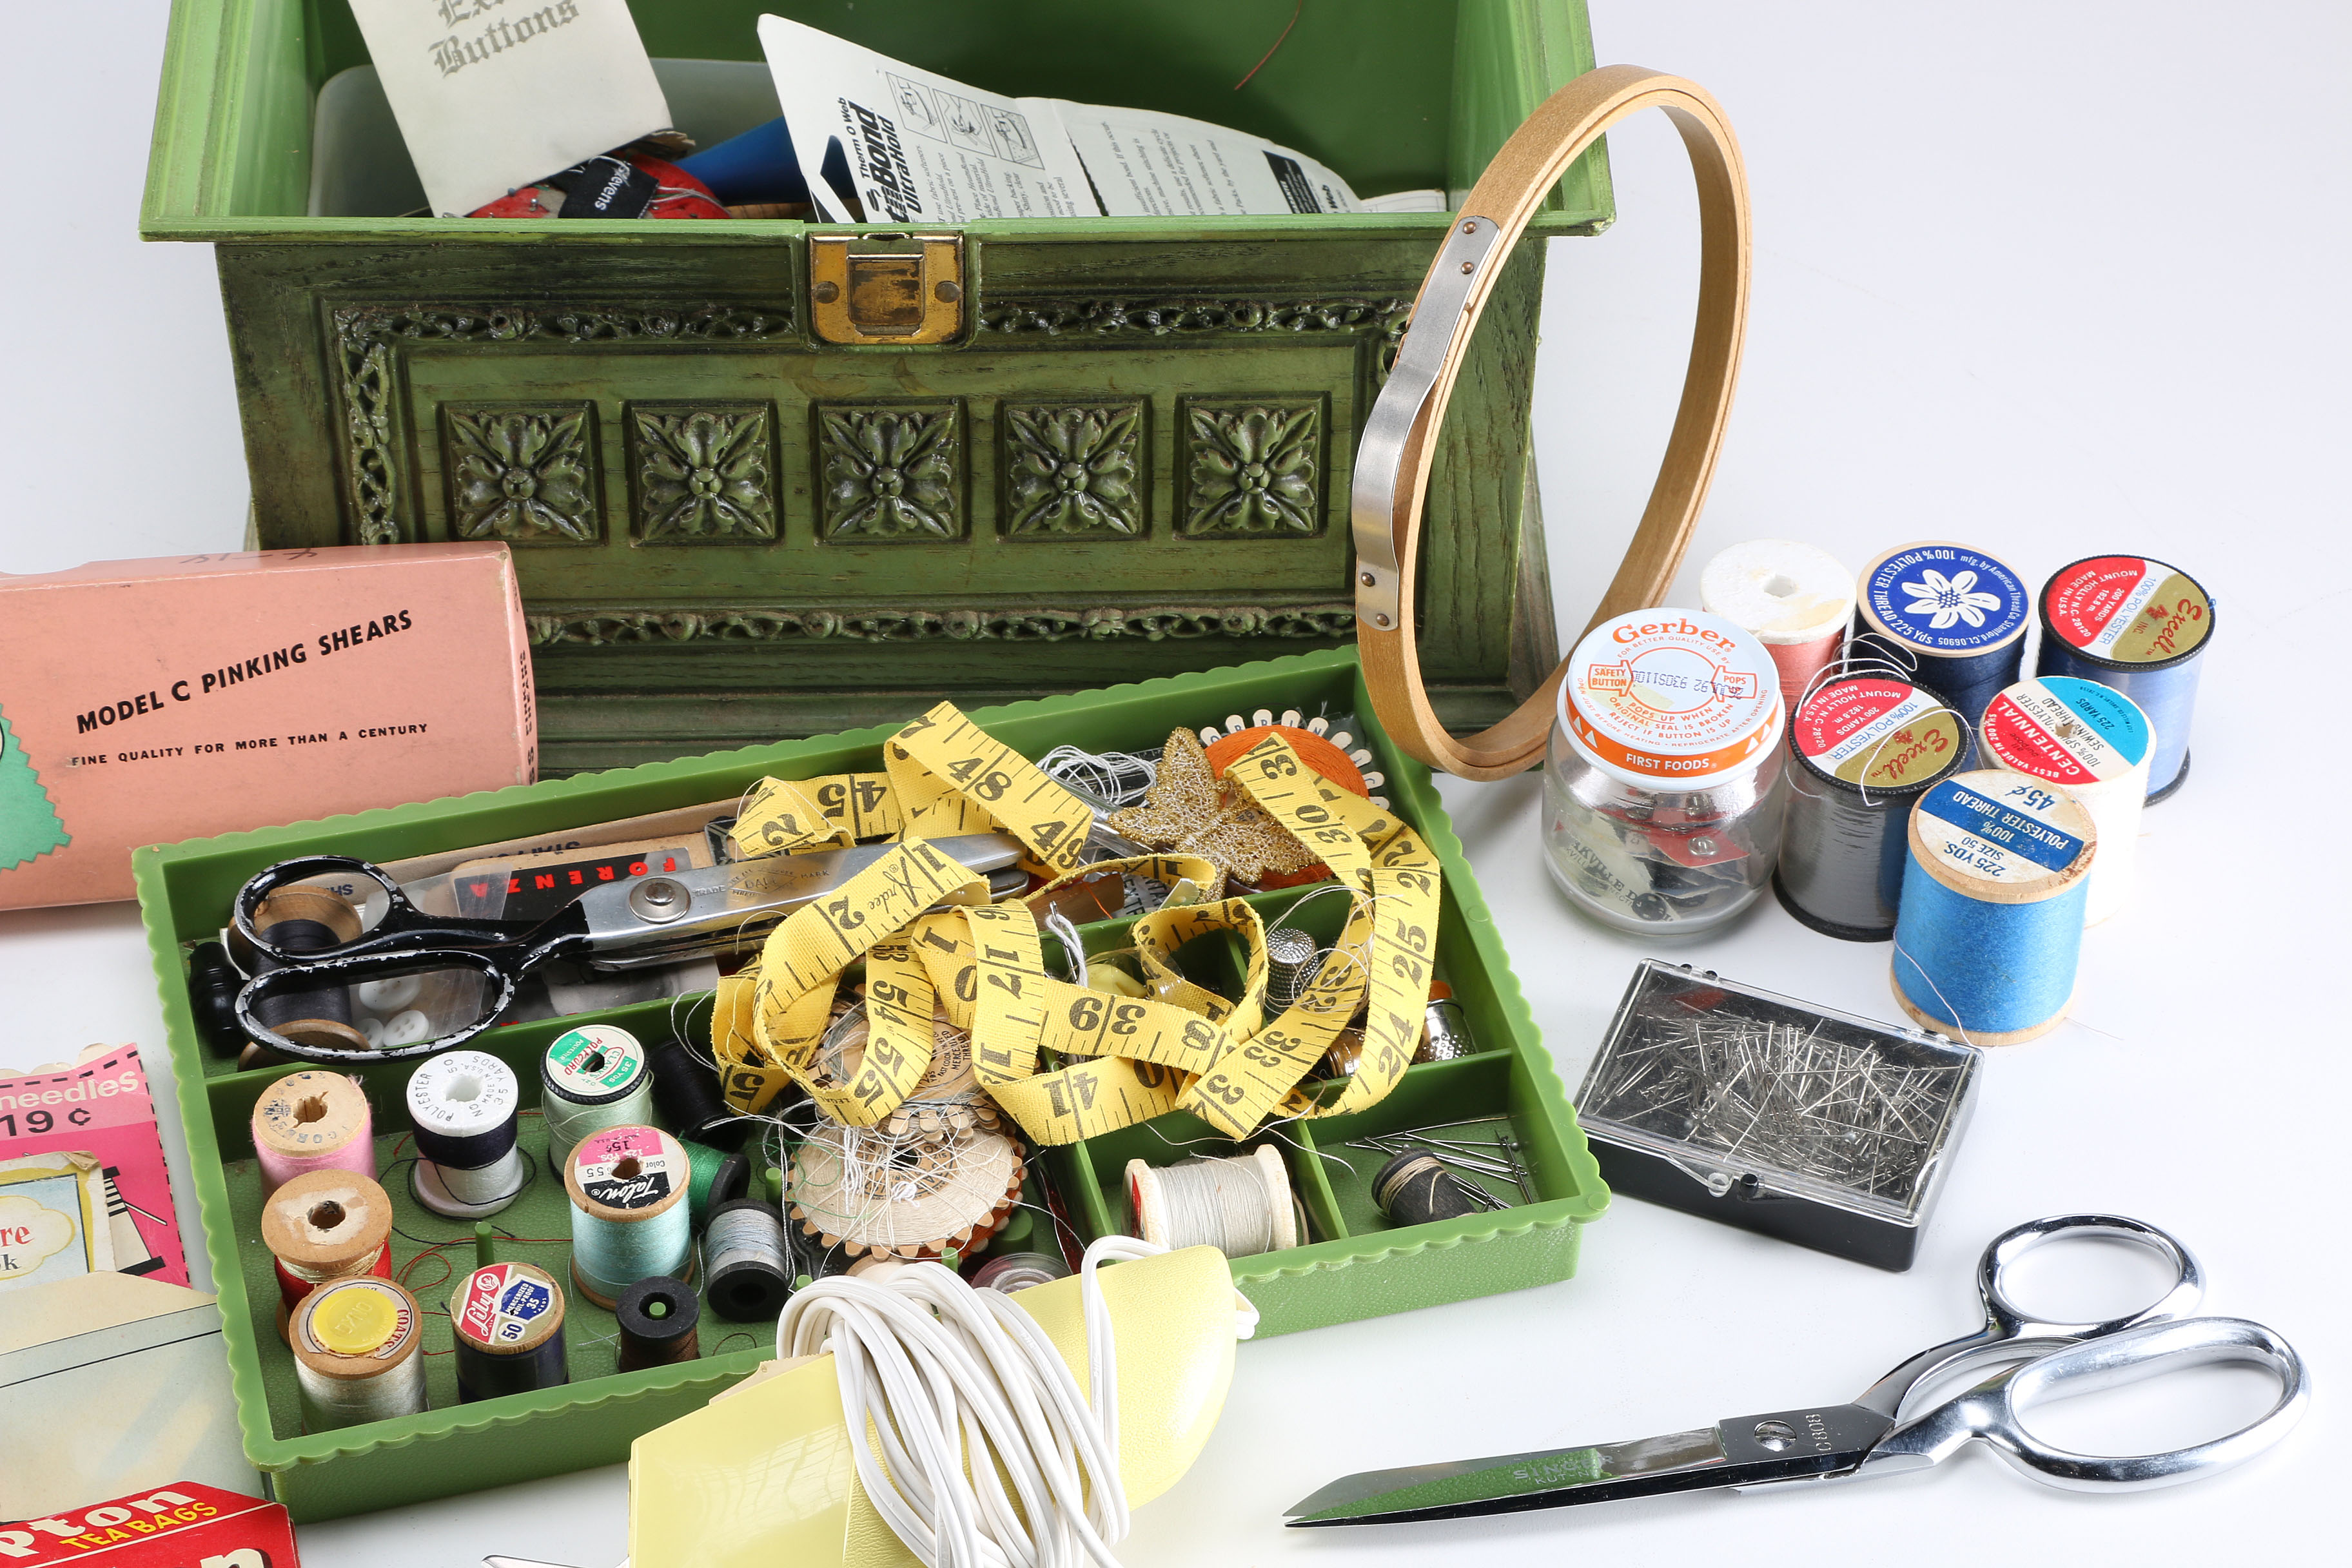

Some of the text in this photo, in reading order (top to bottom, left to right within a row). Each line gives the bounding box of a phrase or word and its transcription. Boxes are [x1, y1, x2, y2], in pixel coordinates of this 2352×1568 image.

[428, 0, 580, 78] Buttons
[837, 97, 870, 179] Therm O Web
[877, 114, 923, 214] UltraHold
[939, 153, 951, 172] piece
[972, 193, 982, 211] Place
[1874, 549, 1955, 645] 100% POLYESTER THREAD 225 Yds
[2063, 571, 2096, 596] MADE IN
[2095, 589, 2110, 607] 182.8
[1938, 555, 2021, 646] mfg. by American Thread 06905
[2072, 570, 2137, 637] MOUNT HOLLY 28120
[2095, 588, 2124, 622] 200 YARDS
[2099, 577, 2157, 645] 100% POLYESTER
[1612, 618, 1736, 650] Gerber
[2133, 622, 2149, 634] INC.
[2154, 599, 2202, 654] Excell
[1618, 636, 1731, 664] FOR BETTER QUALITY USE BY
[77, 609, 412, 734] MODEL C PINKING SHEARS
[1592, 678, 1626, 687] BUTTON
[1594, 668, 1626, 677] SAFETY
[1723, 675, 1747, 685] POPS
[1609, 697, 1650, 727] ORIGINAL
[1698, 704, 1734, 727] BROKEN
[1629, 702, 1655, 718] POPS
[1680, 707, 1713, 721] WHEN
[1817, 685, 1858, 707] MADE IN
[1828, 694, 1857, 711] HOLLY
[1842, 705, 1863, 719] 182.8
[1577, 678, 1768, 747] OPEN JUST BEFORE HEATING REFRIGERATE AFTER OPENING
[1609, 712, 1640, 731] REJECT
[1718, 719, 1731, 728] UP
[1836, 707, 1879, 736] 200 YARDS
[2043, 698, 2073, 727] THREAD
[2075, 698, 2115, 730] 225 YARDS
[72, 723, 427, 766] FINE QUALITY FOR MORE THAN A CENTURY
[1812, 728, 1826, 748] 28120
[1830, 702, 1918, 760] 100% POLYESTER
[1998, 701, 2080, 775] CENTENNIAL
[2010, 733, 2039, 757] purpose
[1626, 753, 1709, 770] FIRST FOODS
[1883, 729, 1948, 780] Excell
[1988, 728, 2060, 778] BEST VALUE IN 200
[2079, 748, 2101, 767] 100%
[946, 757, 1012, 803] 48
[817, 780, 888, 818] 45
[2005, 785, 2055, 811] 45¢
[1953, 790, 2069, 850] POLYESTER THREAD
[1983, 821, 2016, 843] 100%
[1032, 820, 1084, 870] 49
[1944, 840, 2007, 877] 225 YDS.
[1961, 836, 2004, 861] SIZE 50
[469, 857, 676, 897] FORENZA
[691, 870, 830, 896] TRADE MARK
[830, 895, 865, 931] 2
[1393, 918, 1427, 989] 25
[985, 944, 1023, 1000] 17
[1069, 997, 1145, 1034] 39
[444, 1059, 458, 1073] 50
[560, 1039, 584, 1061] POLYESTER
[1378, 1013, 1415, 1087] 24
[473, 1055, 508, 1105] 35 YARDS
[622, 1061, 632, 1072] 35
[854, 1037, 905, 1108] 55
[0, 1070, 139, 1110] needles
[415, 1073, 454, 1122] POLYESTER
[482, 1083, 495, 1104] MADE
[1043, 1072, 1098, 1117] 41
[0, 1110, 55, 1137] 19
[645, 1160, 665, 1168] Color
[599, 1177, 658, 1204] Talon
[466, 1291, 495, 1337] Lily
[505, 1282, 529, 1314] MERCERIZED
[526, 1297, 540, 1309] 35
[384, 1309, 409, 1348] COATS
[502, 1324, 522, 1339] 50
[1805, 1413, 1832, 1452] C808
[59, 1502, 218, 1551] TEA BAGS
